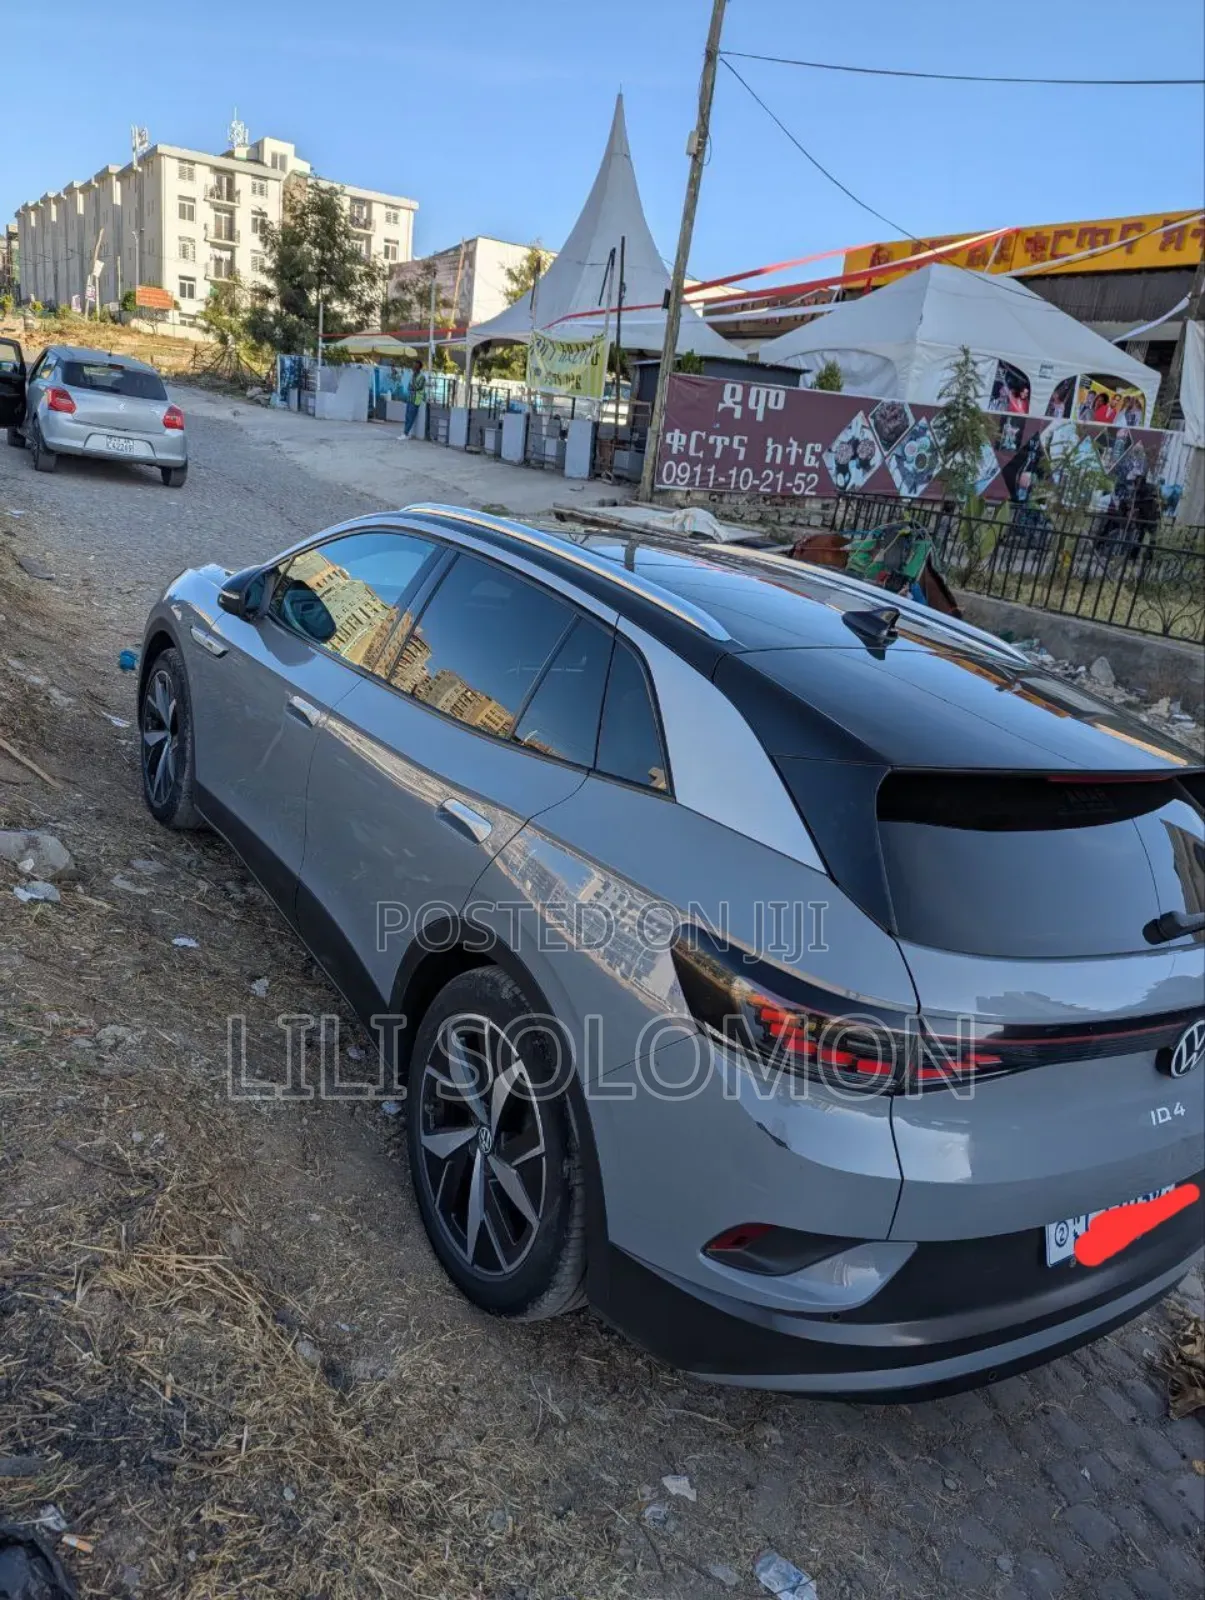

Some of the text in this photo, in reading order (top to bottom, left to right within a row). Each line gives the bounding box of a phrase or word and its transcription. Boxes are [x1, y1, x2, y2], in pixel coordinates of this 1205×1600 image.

[717, 383, 786, 421] ዳሞ
[665, 428, 822, 468] ቁርጥና ክትፎ
[662, 460, 819, 496] 0911-10-21-52
